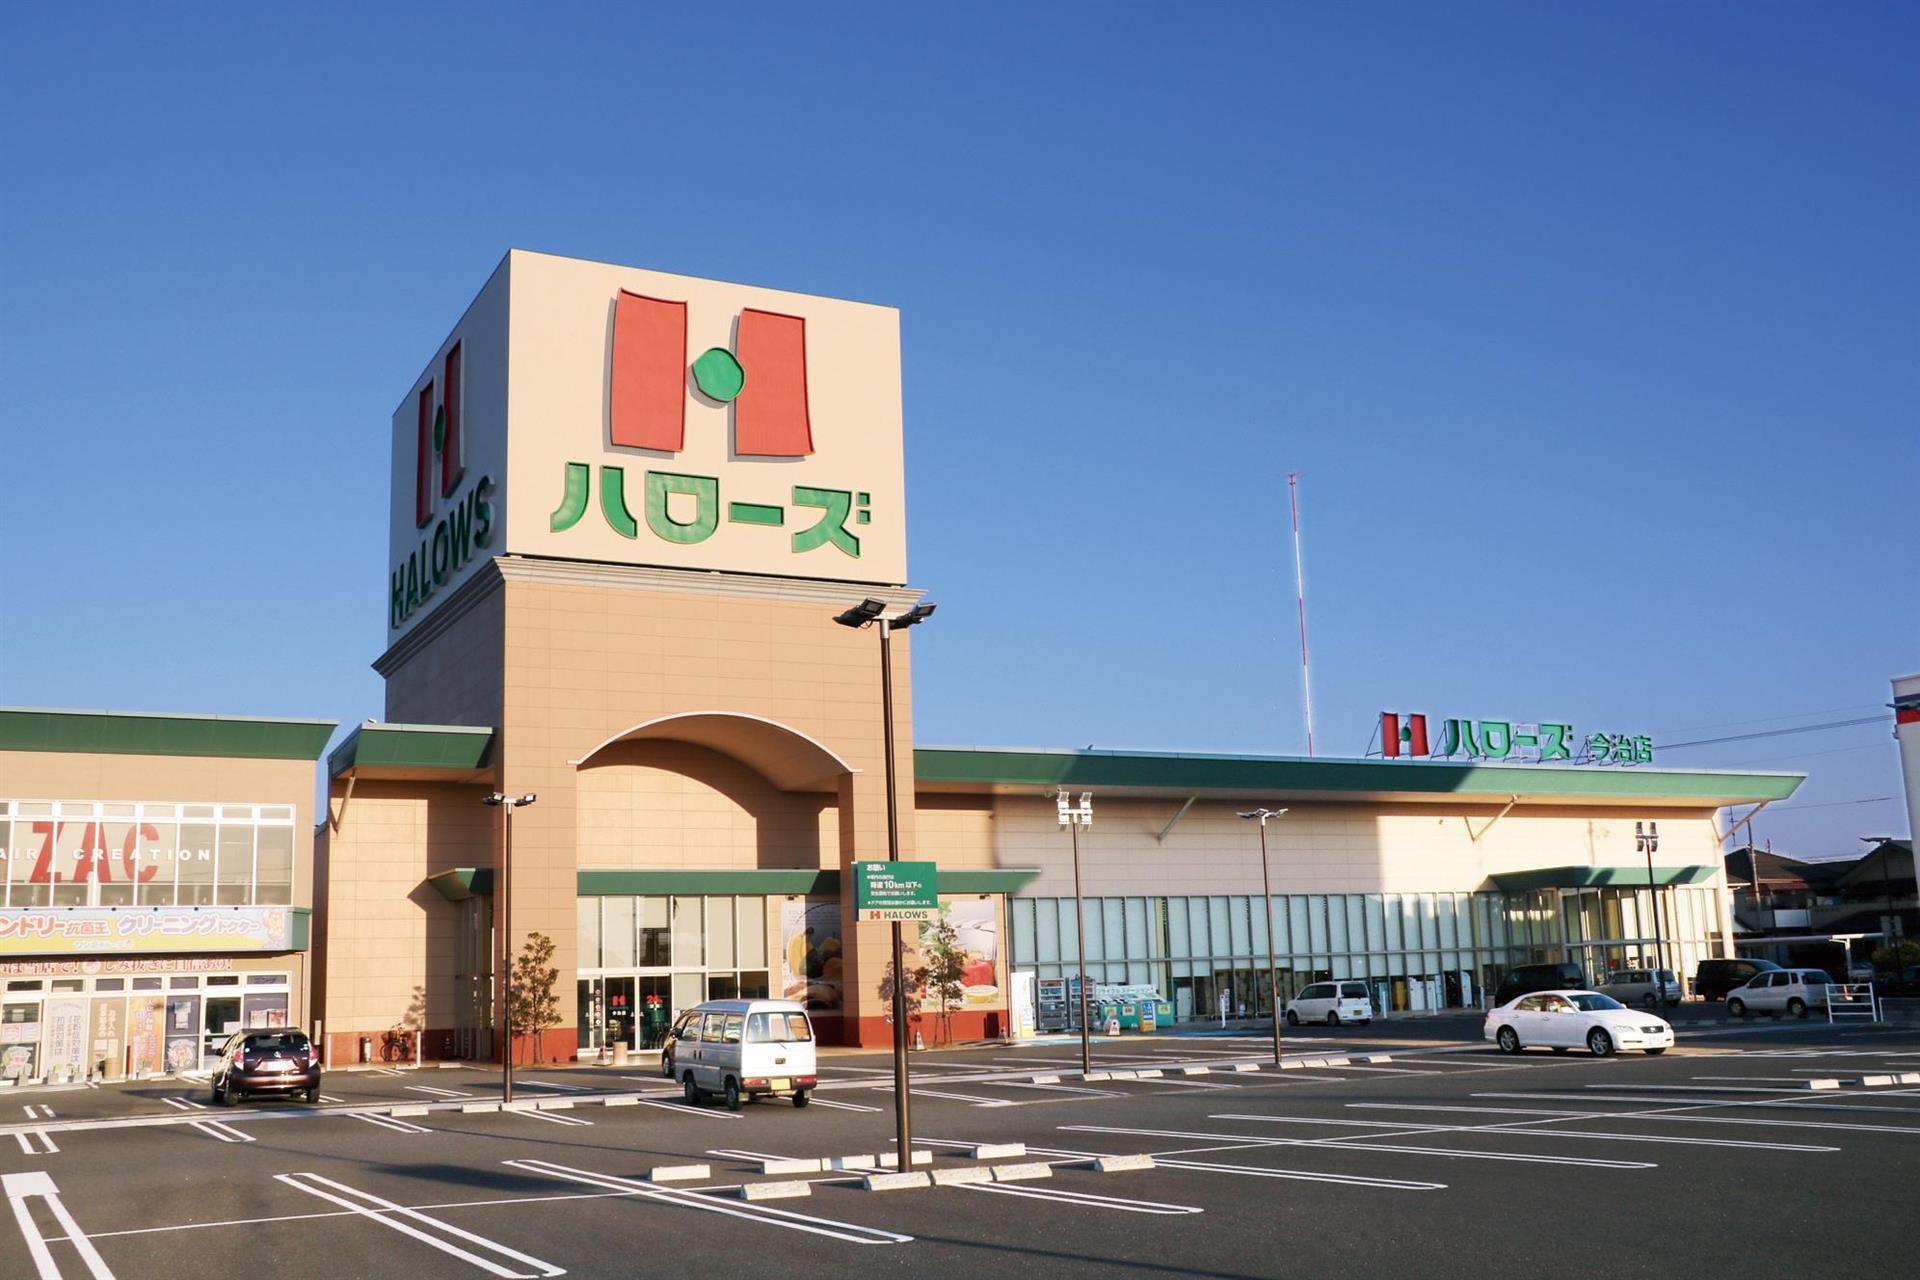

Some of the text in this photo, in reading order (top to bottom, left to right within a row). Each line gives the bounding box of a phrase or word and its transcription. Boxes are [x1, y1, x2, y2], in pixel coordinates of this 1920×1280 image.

[550, 461, 871, 559] ハローズ
[391, 475, 496, 630] HALOWS
[1445, 719, 1573, 760] ハローズ
[1590, 733, 1653, 763] 今治店
[29, 821, 160, 883] ZAC
[72, 848, 210, 861] CREATION
[884, 911, 928, 919] HALOWS
